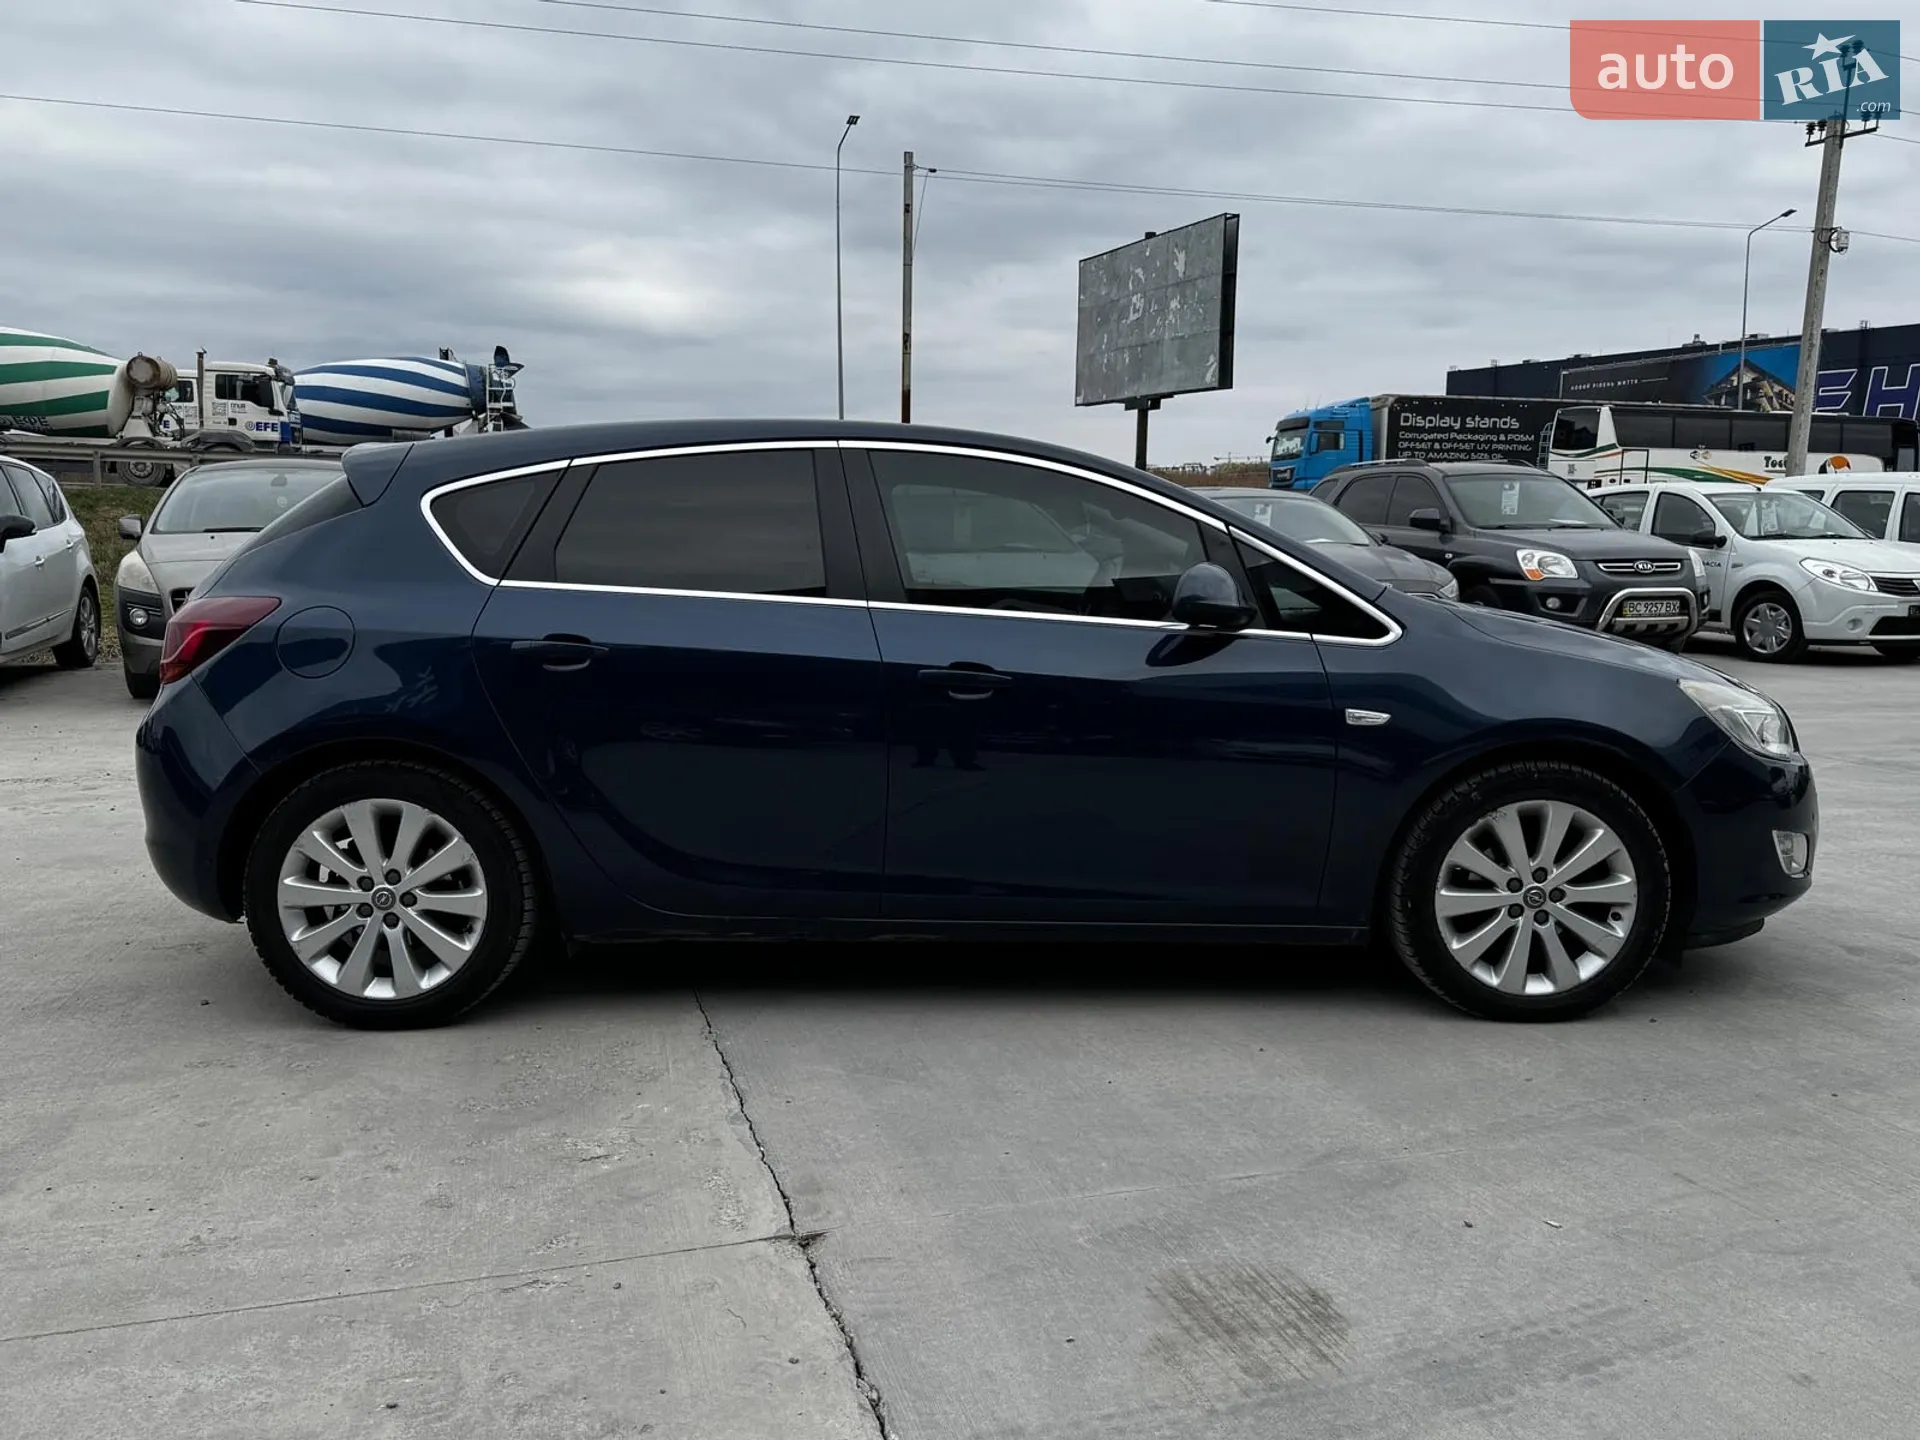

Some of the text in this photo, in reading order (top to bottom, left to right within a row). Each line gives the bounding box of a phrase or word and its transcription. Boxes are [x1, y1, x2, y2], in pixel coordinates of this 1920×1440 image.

[1400, 412, 1520, 430] Display stands
[255, 421, 279, 432] EFE
[1398, 431, 1449, 441] Corrugated
[1450, 432, 1498, 442] Packaging
[1398, 441, 1432, 449] OFFSET
[1442, 442, 1475, 450] OFFSET
[1491, 443, 1532, 451] PRINTING
[1413, 451, 1426, 459] TO
[1427, 452, 1470, 460] AMAZING
[1471, 452, 1490, 460] SIZE
[1628, 602, 1679, 612] BC 9257 BX
